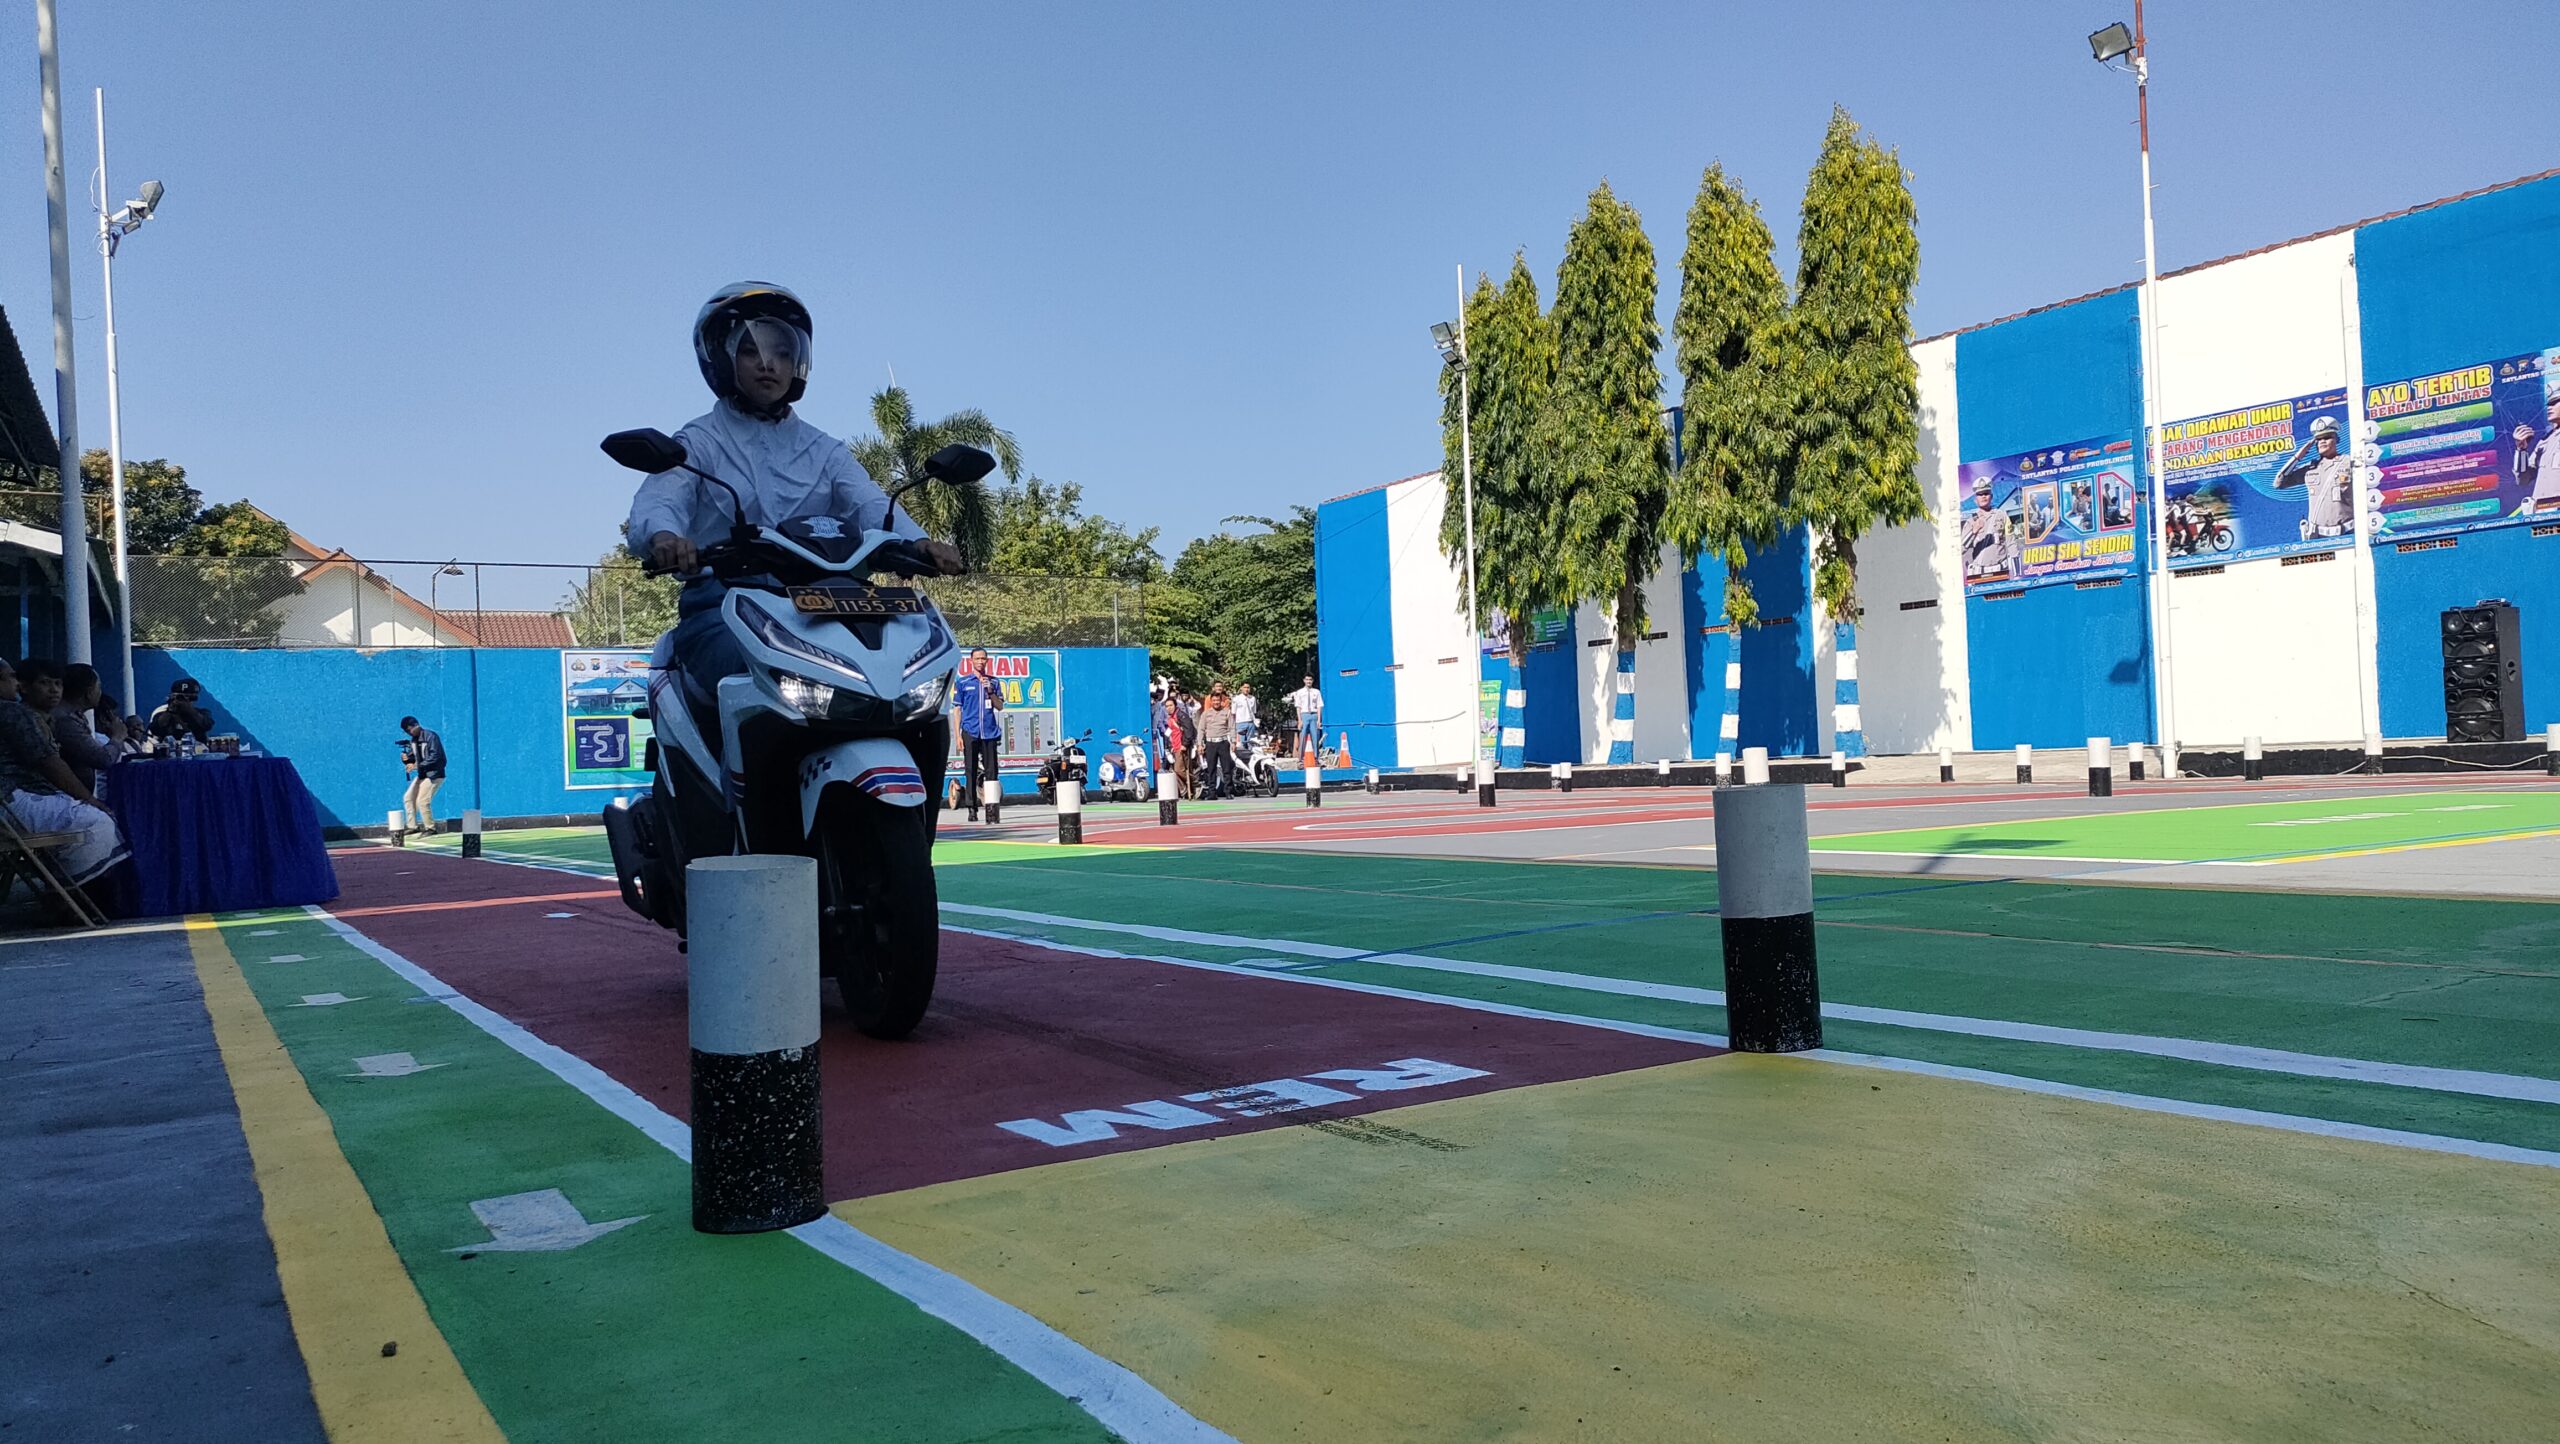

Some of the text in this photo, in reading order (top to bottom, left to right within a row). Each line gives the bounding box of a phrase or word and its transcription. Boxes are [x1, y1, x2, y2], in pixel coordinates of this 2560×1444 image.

[2368, 367, 2492, 409] AYO TERTIB
[2369, 399, 2432, 420] BERLALU
[2437, 387, 2492, 406] LINTAS
[2187, 413, 2248, 437] DIBAWAH
[2251, 403, 2291, 425] UMUR
[2150, 439, 2204, 459] DARANG
[2208, 422, 2292, 448] MENGENDARAI
[2150, 450, 2222, 474] NDARAAN
[2225, 437, 2295, 462] BERMOTOR
[2367, 449, 2374, 458] 2
[2021, 468, 2058, 480] SATLANTAS
[2059, 464, 2085, 474] POLRES
[2087, 454, 2134, 469] PROBOLINGGO
[2368, 472, 2375, 481] 3
[2369, 495, 2376, 503] 4
[2371, 518, 2378, 526] 5
[2023, 535, 2134, 565] URUS SIM SENDIRI
[2023, 564, 2054, 577] Jangan
[2093, 556, 2114, 567] Jasa
[862, 588, 879, 598] X
[840, 600, 918, 612] 1155-37
[958, 657, 1030, 677] UIAN
[181, 683, 189, 692] P
[1029, 679, 1043, 704] 4
